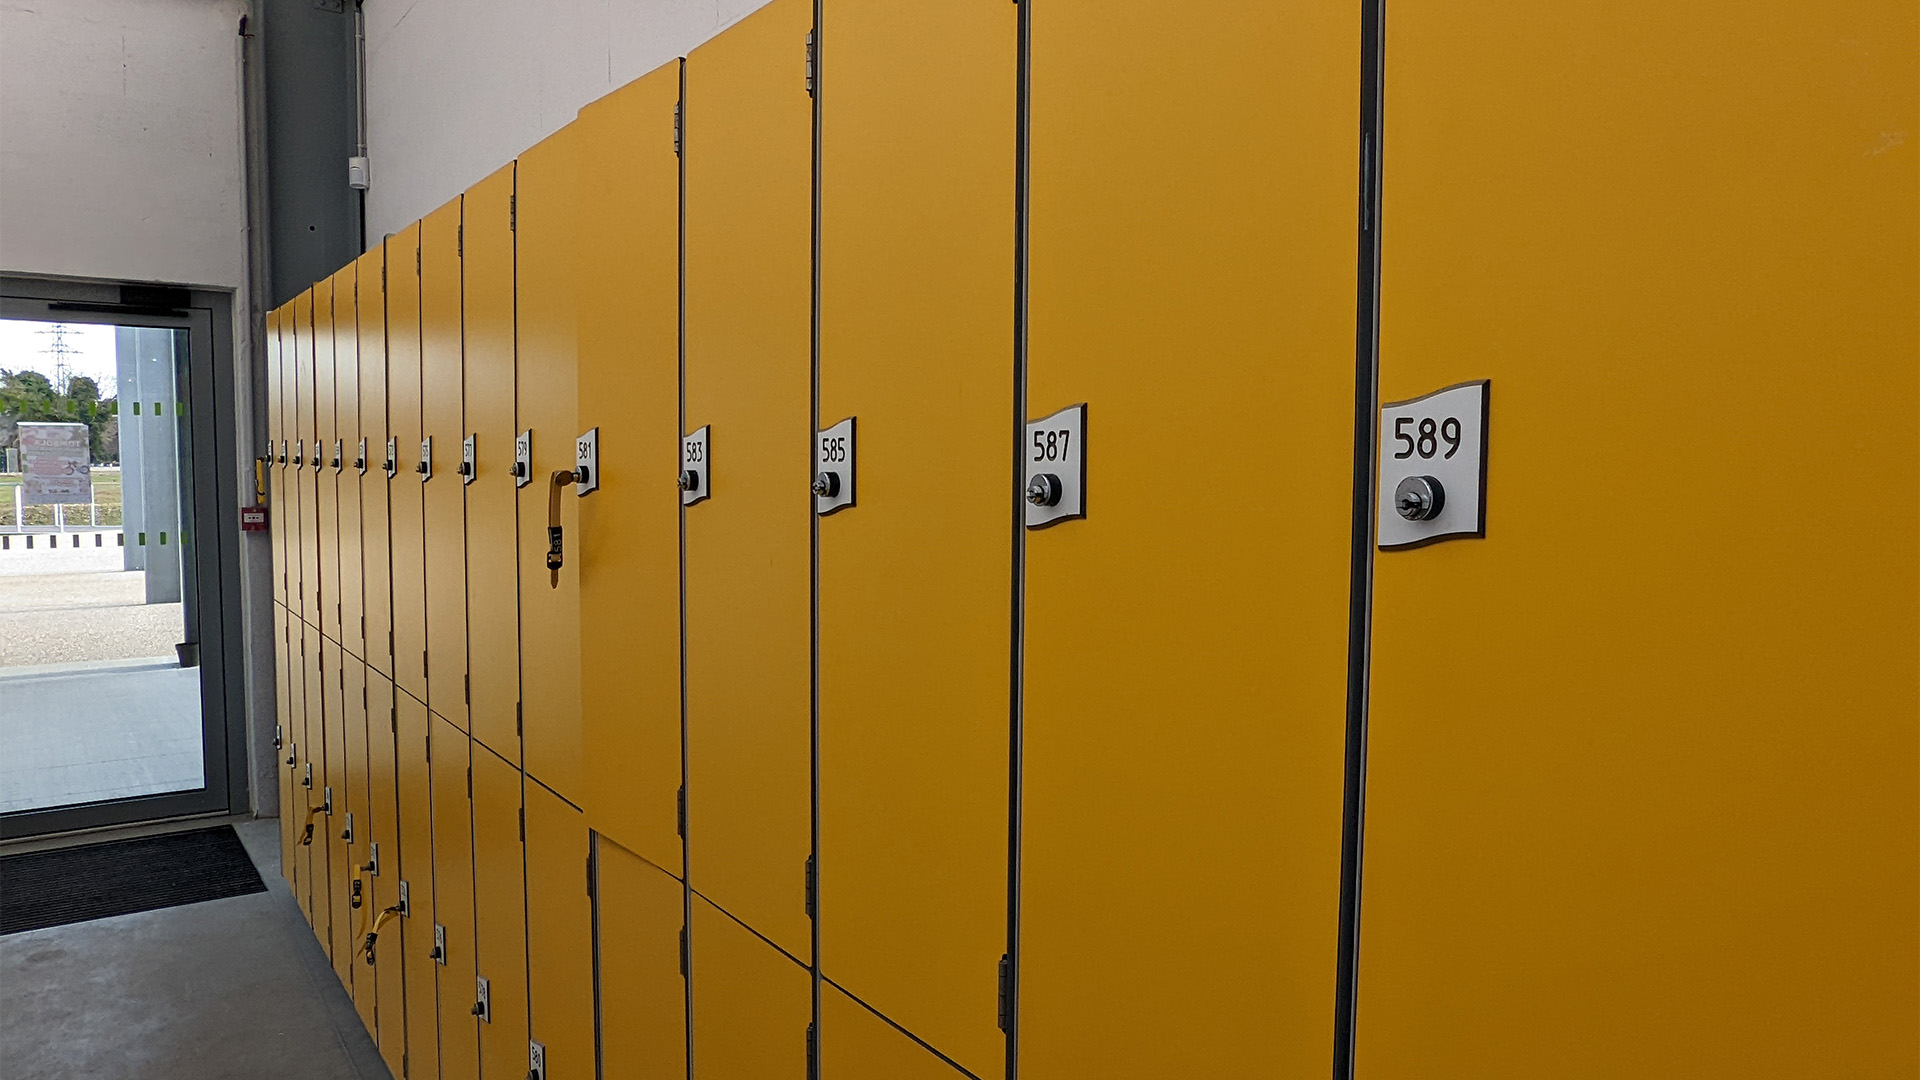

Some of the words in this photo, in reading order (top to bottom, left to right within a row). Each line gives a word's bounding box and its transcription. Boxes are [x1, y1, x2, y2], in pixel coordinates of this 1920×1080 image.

[518, 442, 527, 456] 579
[1033, 430, 1070, 462] 587
[1393, 416, 1462, 461] 589
[579, 442, 592, 459] 581
[686, 441, 703, 463] 583
[822, 437, 846, 464] 585
[553, 533, 562, 553] 581
